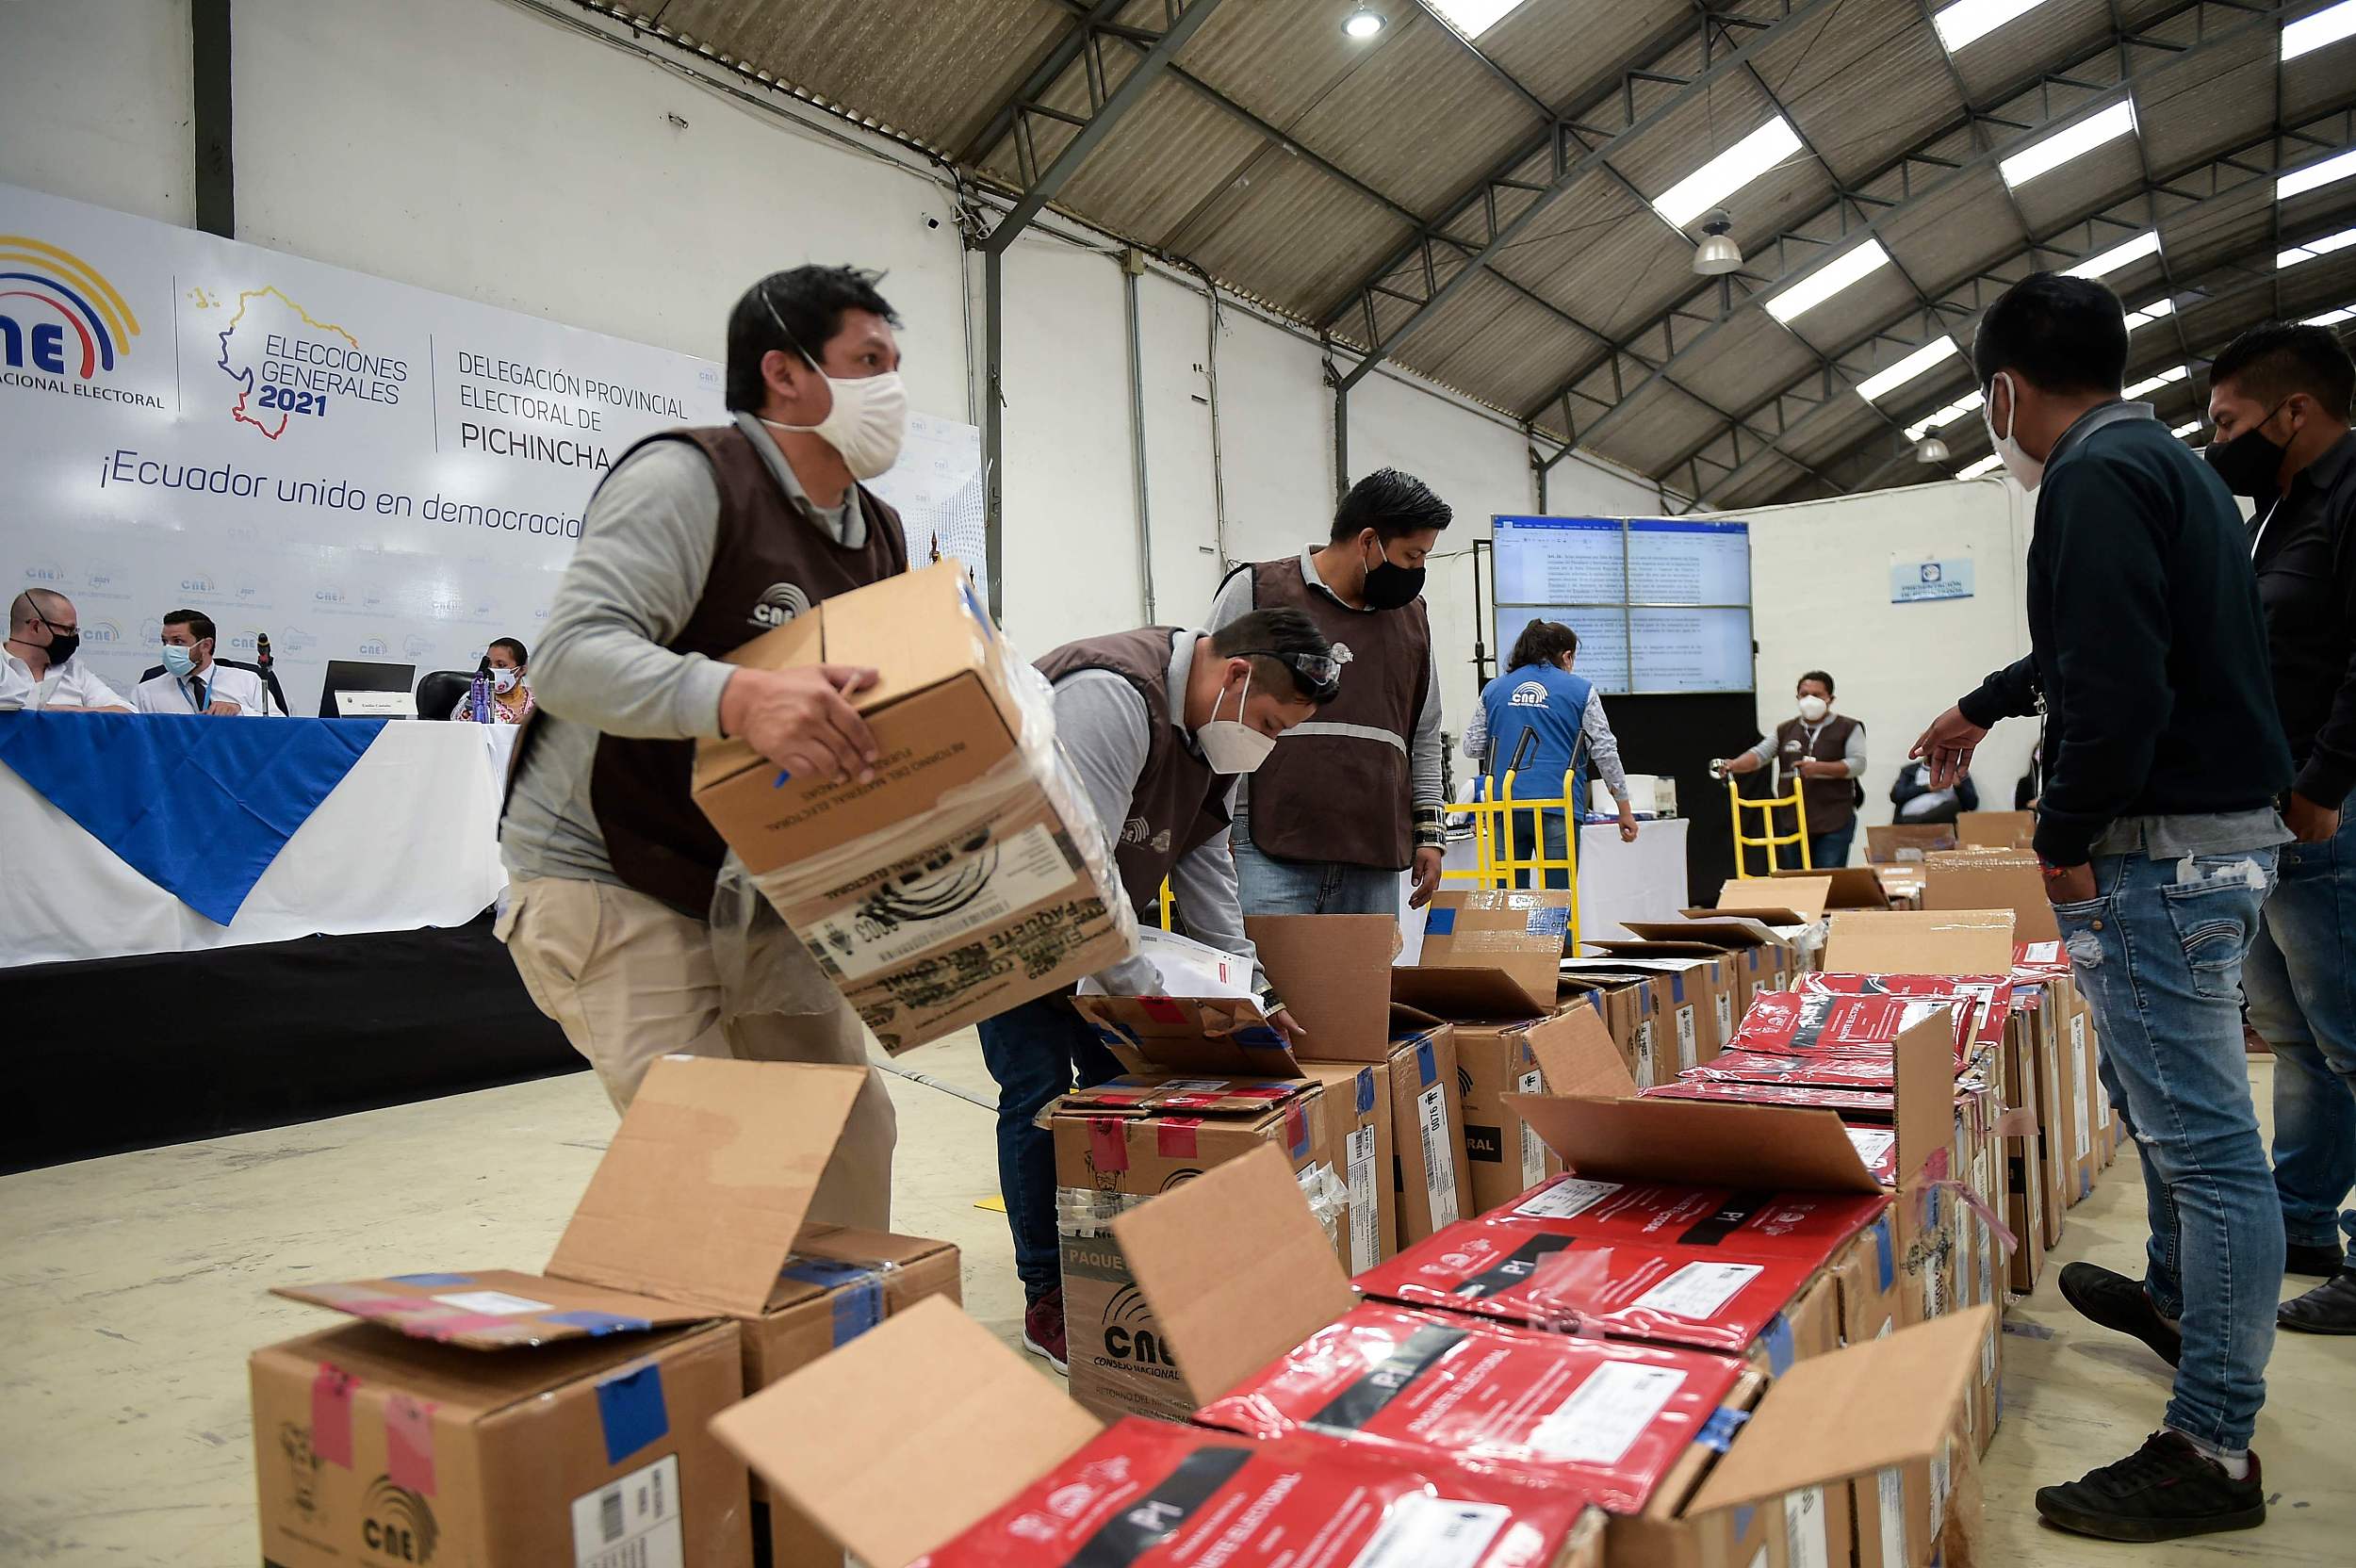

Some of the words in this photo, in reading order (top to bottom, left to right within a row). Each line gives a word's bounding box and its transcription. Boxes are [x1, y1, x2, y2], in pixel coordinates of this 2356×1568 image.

[266, 335, 407, 381] ELECCIONES
[74, 384, 165, 409] ELECTORAL
[258, 384, 327, 417] 2021
[262, 361, 400, 405] GENERALES
[459, 351, 581, 397] DELEGACIÓN
[585, 380, 688, 419] PROVINCIAL
[461, 384, 573, 426] ELECTORAL
[578, 409, 602, 432] DE
[462, 422, 611, 471] PICHINCHA
[100, 449, 268, 498] ¡Ecuador
[277, 476, 366, 512] unido
[376, 492, 412, 517] en
[1430, 1105, 1440, 1131] 0076
[1730, 1210, 1745, 1222] P1
[1069, 1250, 1123, 1270] PAQUE
[1501, 1259, 1535, 1276] P1
